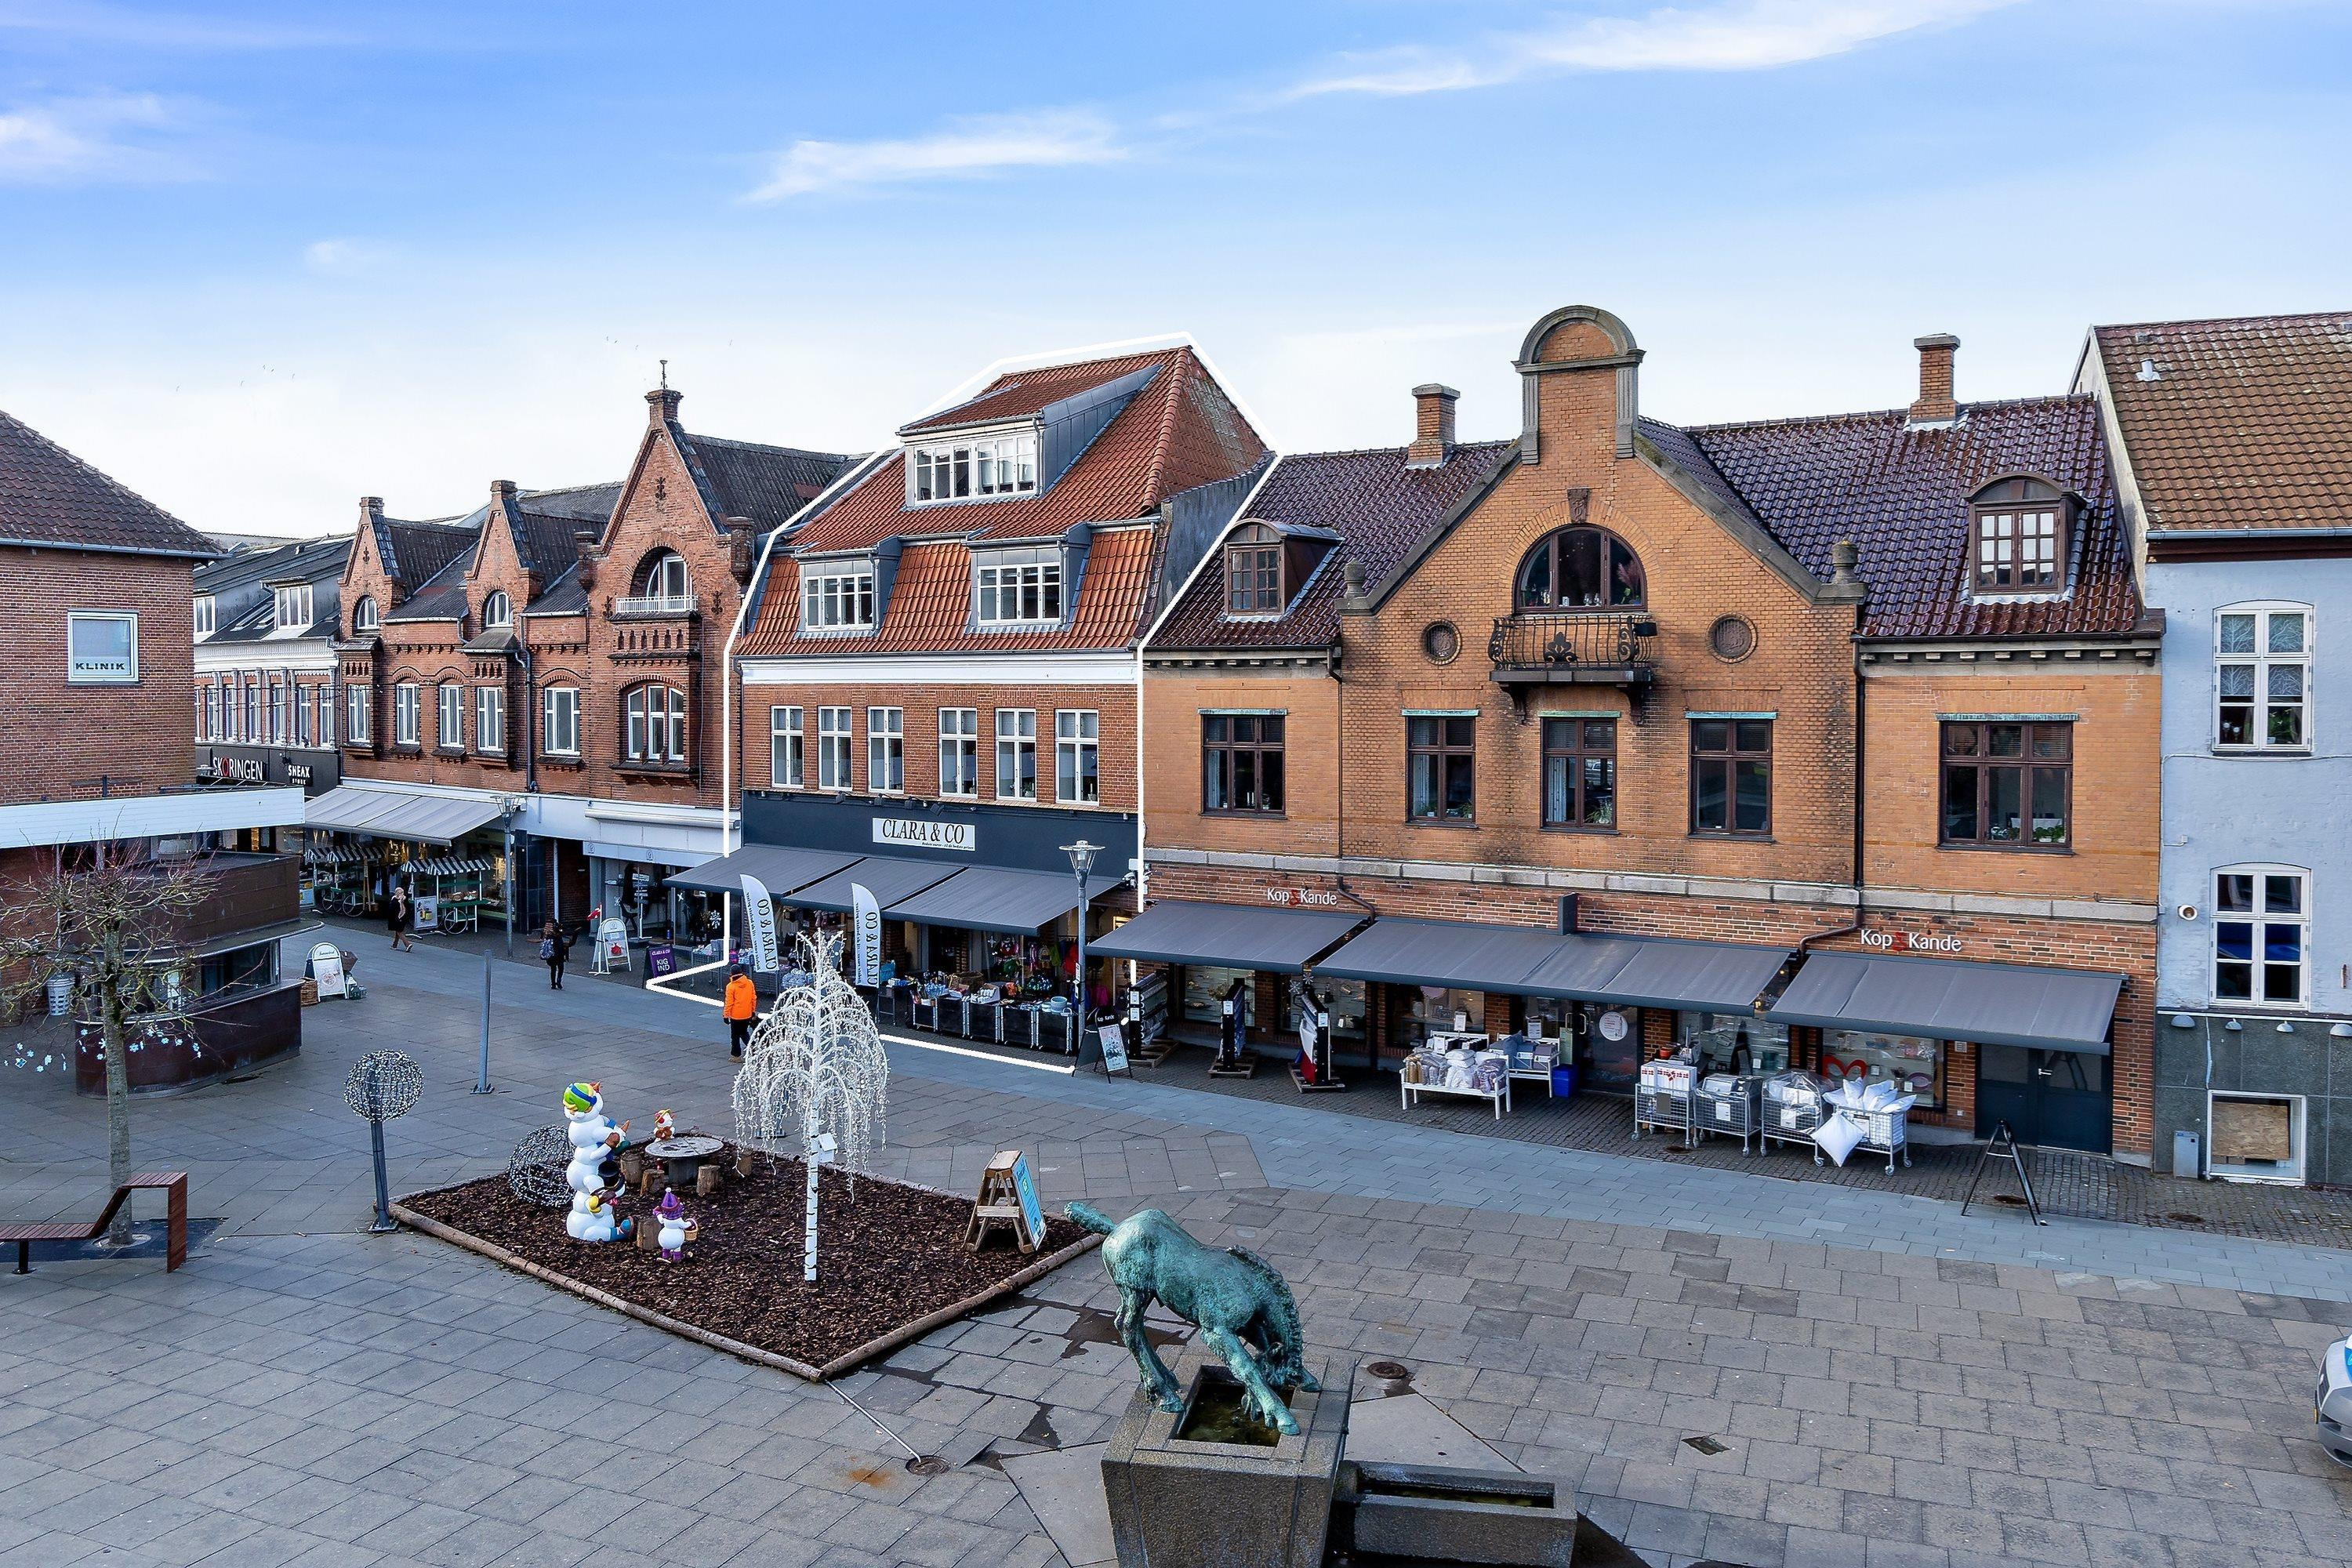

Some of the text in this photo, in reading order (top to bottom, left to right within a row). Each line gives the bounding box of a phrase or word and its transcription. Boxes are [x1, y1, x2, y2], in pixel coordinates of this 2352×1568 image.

[212, 757, 263, 781] SKORINGEN
[288, 764, 310, 779] SNEAX
[882, 818, 964, 844] CLARA & CO
[1267, 887, 1290, 905] Kop
[1300, 889, 1338, 905] Kande
[1860, 929, 1893, 950] Kop
[1908, 932, 1962, 952] Kande
